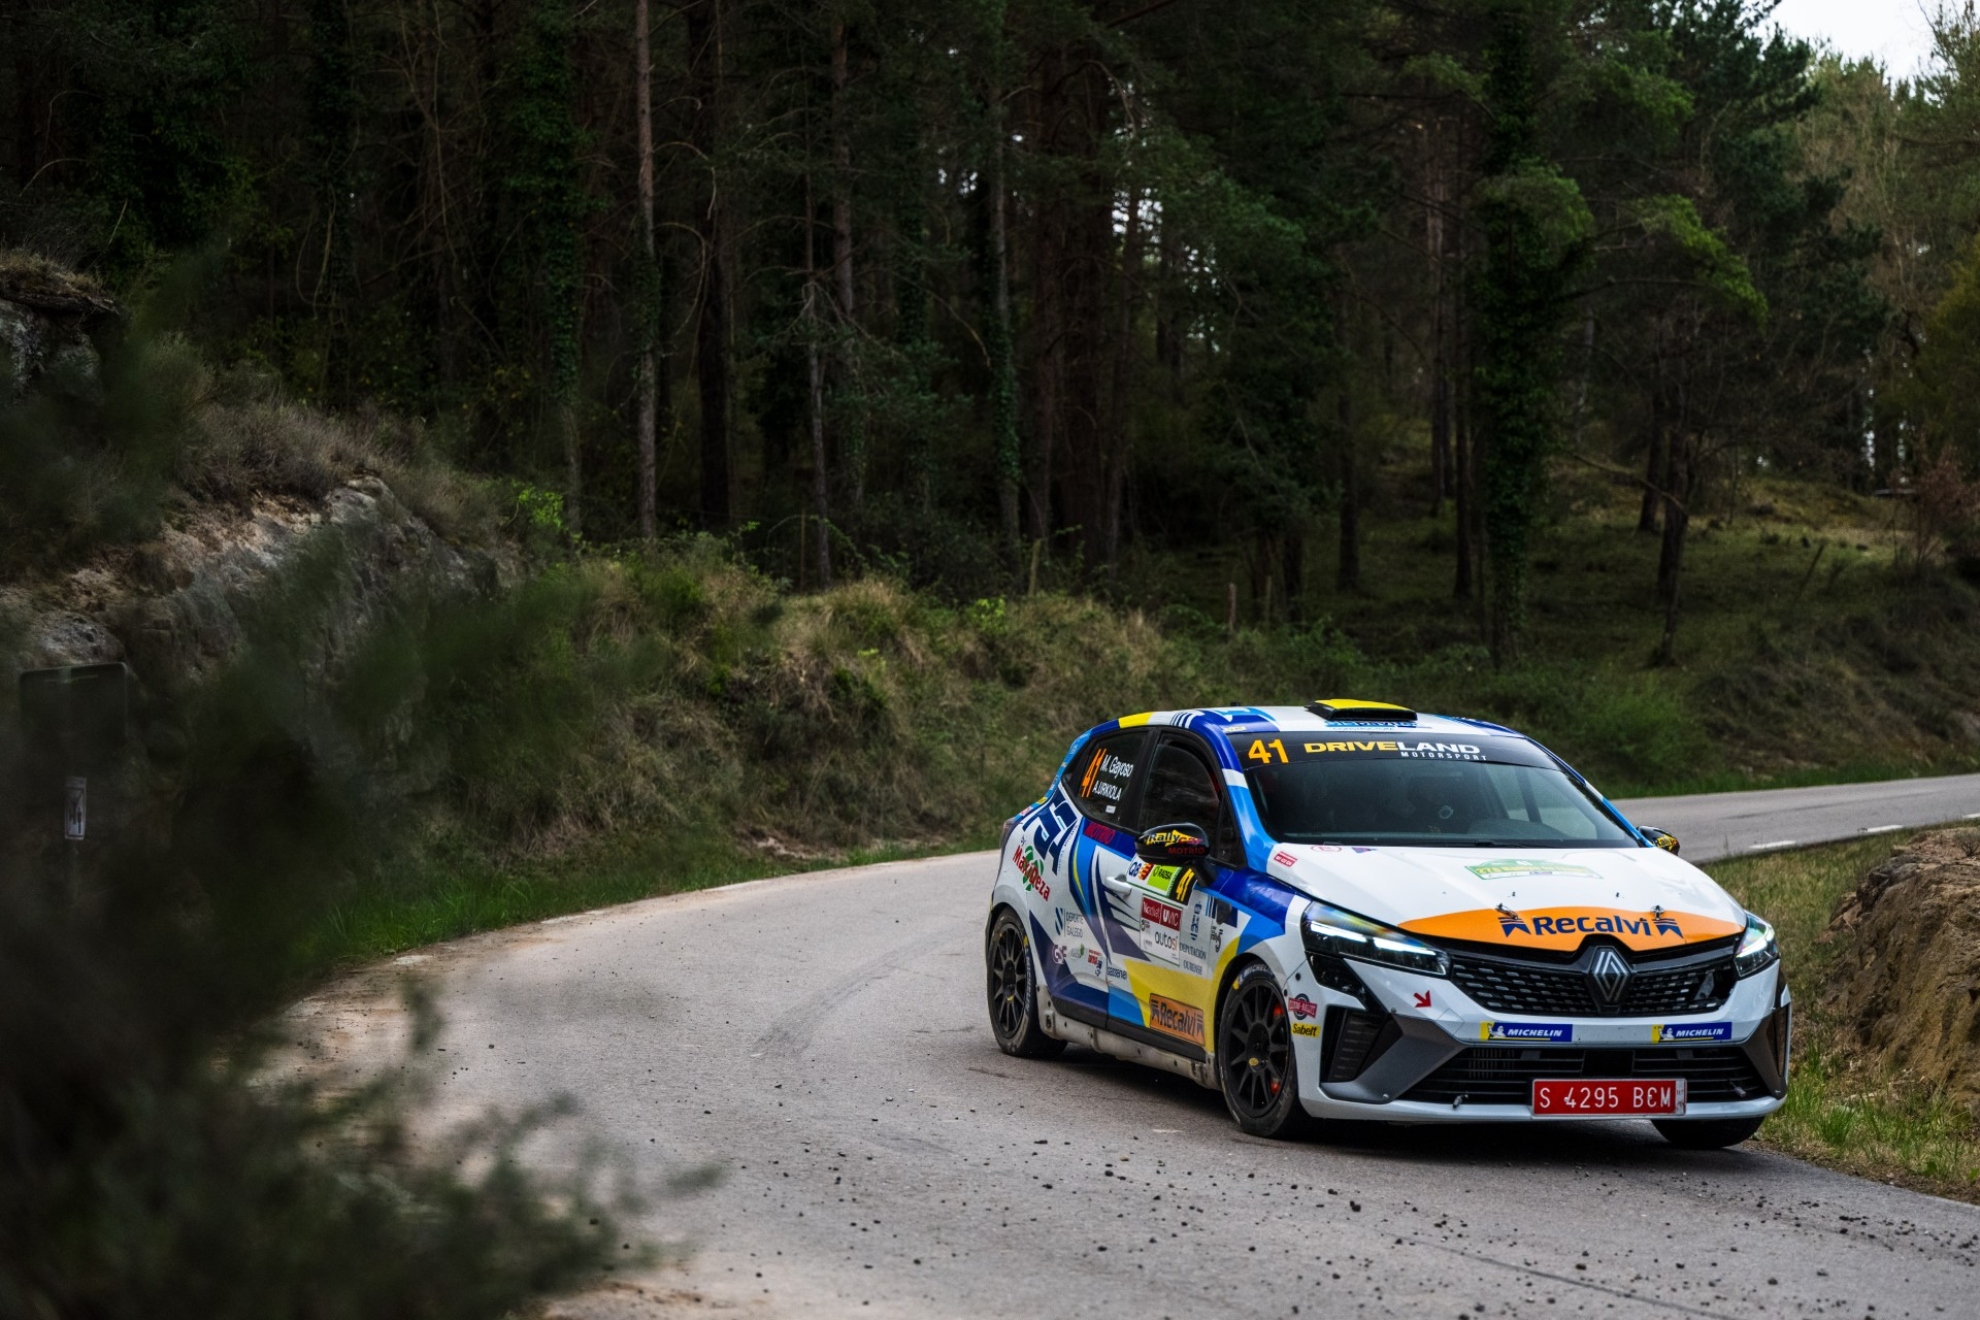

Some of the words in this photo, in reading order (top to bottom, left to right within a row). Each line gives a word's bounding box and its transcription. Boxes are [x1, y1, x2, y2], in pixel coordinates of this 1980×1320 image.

[1247, 738, 1290, 764] 41
[1303, 741, 1481, 755] DRIVELAND
[1400, 752, 1488, 761] MOTORSPORT
[1081, 748, 1107, 798] 41
[1109, 756, 1134, 779] Gayoso
[1084, 821, 1115, 844] MOTRIO
[1168, 846, 1205, 856] MOTRIO
[1175, 867, 1195, 902] 41
[1531, 915, 1653, 936] Recalvi
[1159, 1001, 1196, 1037] Recalvi
[1292, 1023, 1318, 1037] Sabelt
[1507, 1028, 1563, 1038] MICHELIN
[1675, 1027, 1724, 1038] MICHELIN
[1539, 1087, 1551, 1108] S
[1563, 1087, 1619, 1109] 4295
